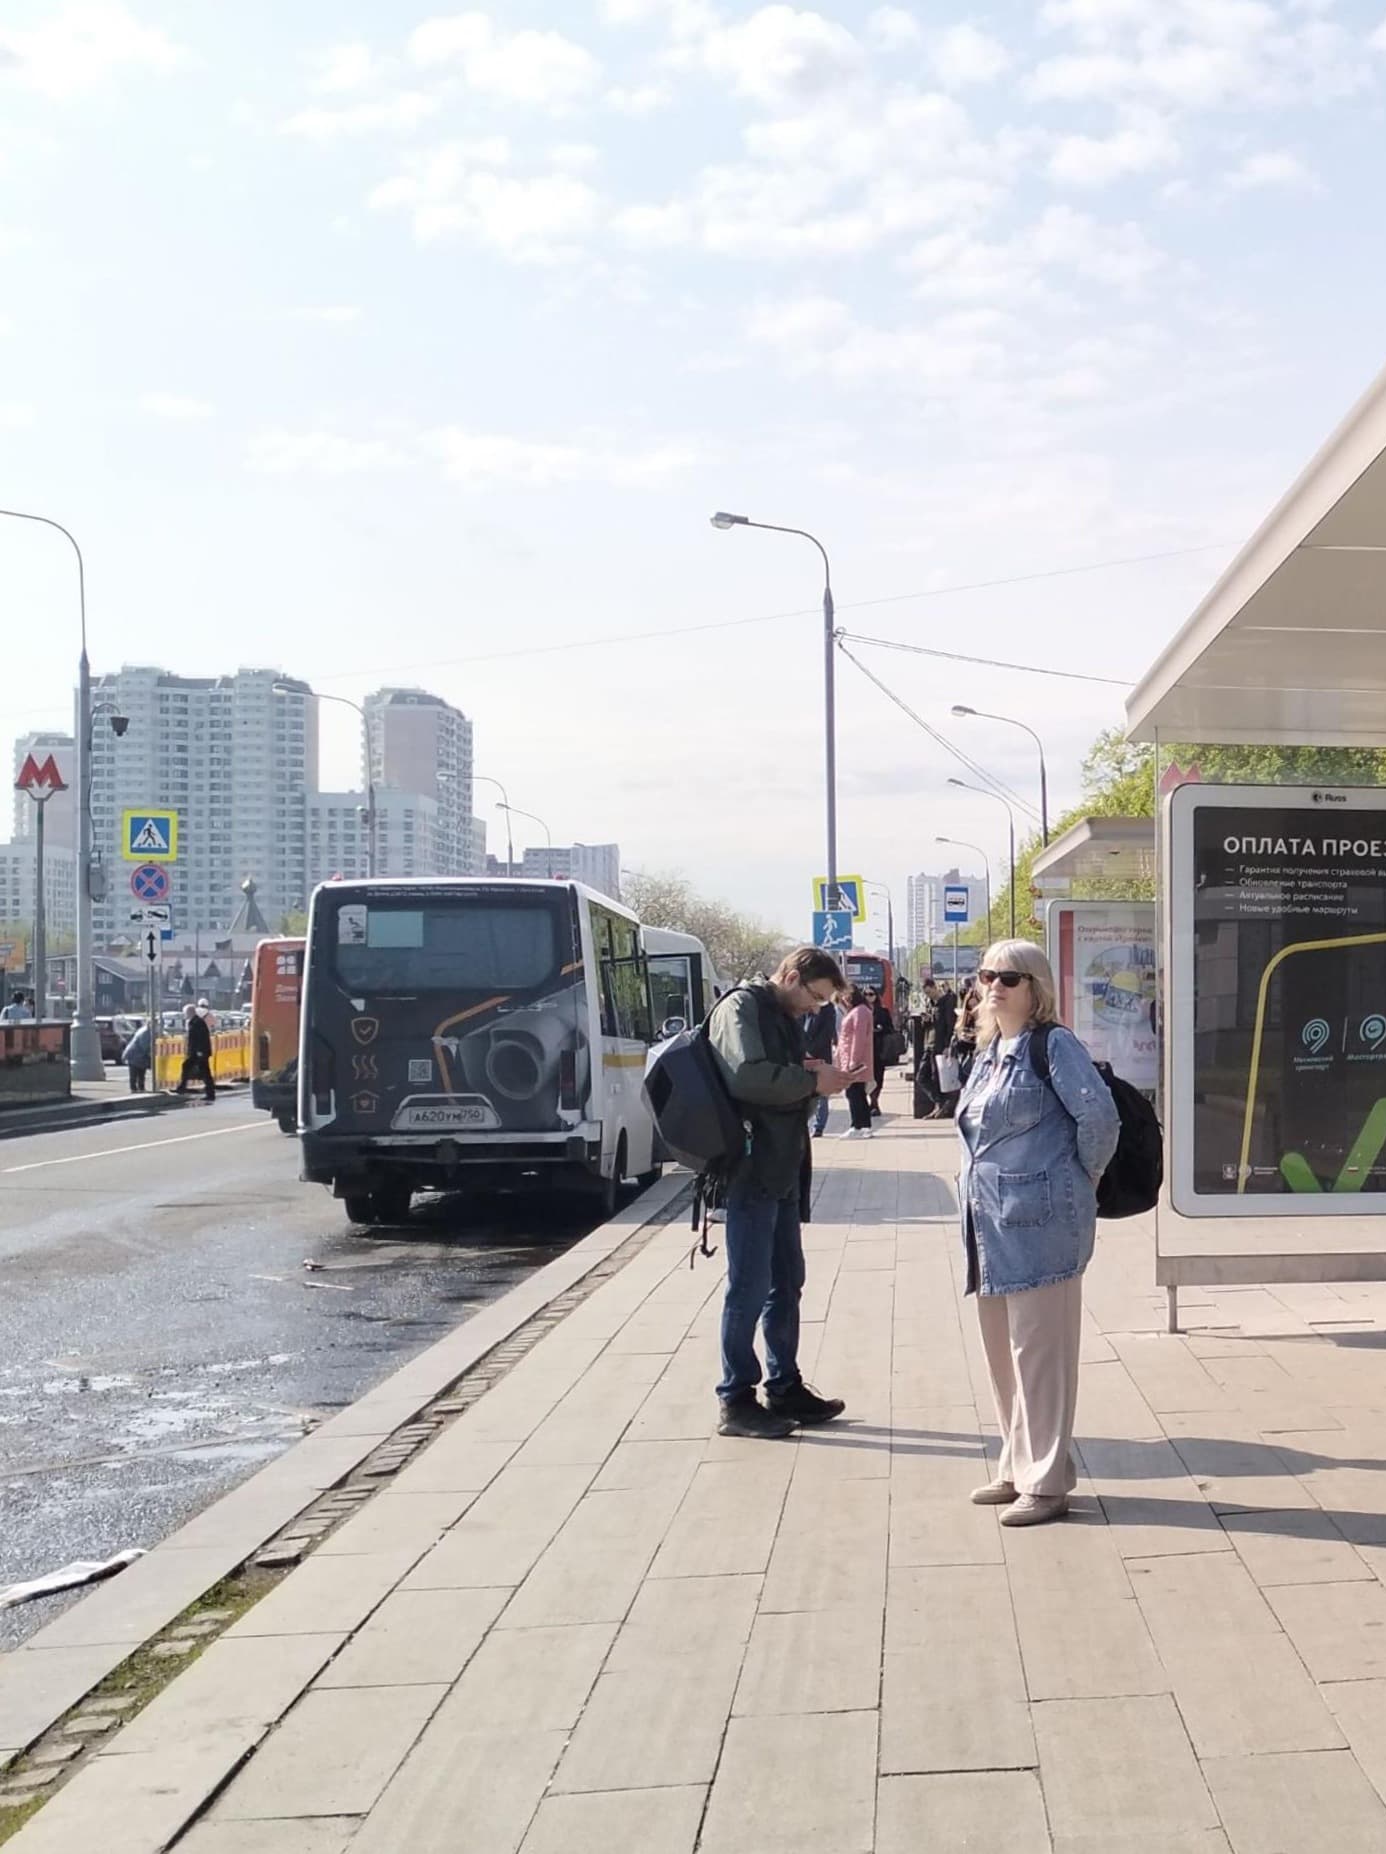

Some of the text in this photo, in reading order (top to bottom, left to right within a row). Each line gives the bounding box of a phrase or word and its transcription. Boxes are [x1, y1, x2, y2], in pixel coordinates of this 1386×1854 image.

[1223, 836, 1316, 855] ОПЛАТА
[1239, 865, 1280, 877] Гарантия
[1283, 867, 1329, 878] получения
[1331, 866, 1376, 879] страховой
[1239, 877, 1348, 890] Обновление транспорта
[1239, 890, 1345, 903] Актуальное расписание
[1239, 903, 1359, 916] Новые удобные маршруты
